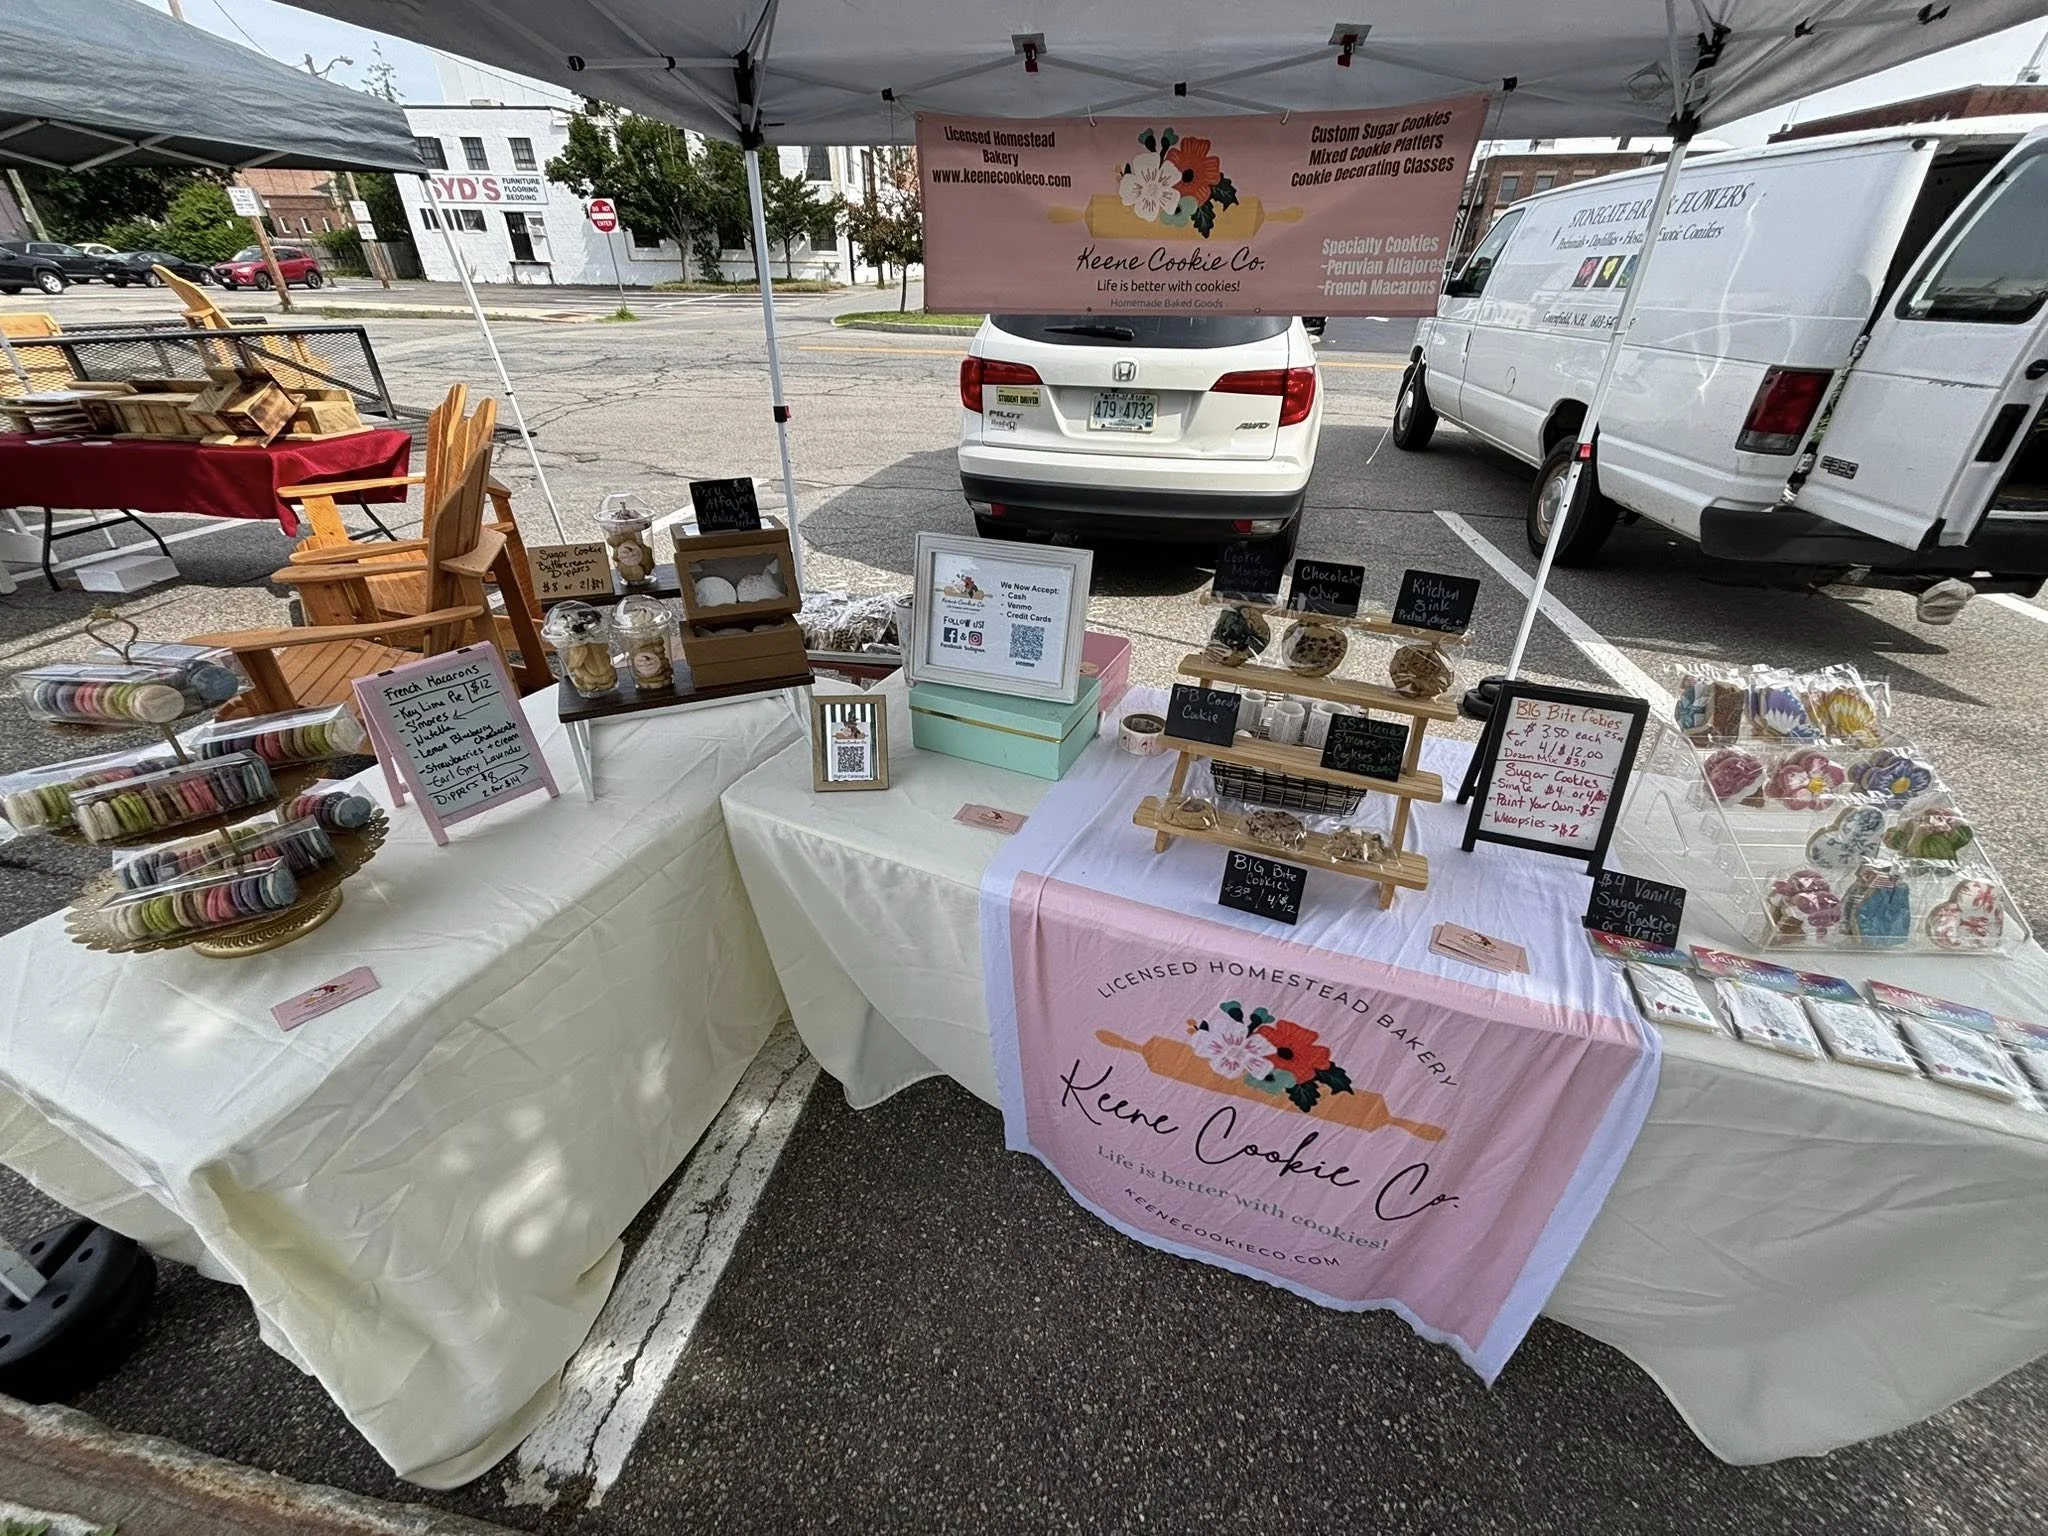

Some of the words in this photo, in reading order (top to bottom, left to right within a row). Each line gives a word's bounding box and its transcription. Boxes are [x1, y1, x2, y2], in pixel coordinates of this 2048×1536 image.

[1311, 125, 1360, 144] Custom
[1361, 119, 1399, 141] Sugar
[1400, 110, 1452, 134] Cookies
[944, 126, 991, 146] Licensed
[993, 130, 1056, 149] Homestead
[982, 149, 1019, 168] Bakery
[1308, 146, 1347, 167] Mixed
[1350, 141, 1391, 162] Cookie
[1392, 133, 1444, 154] Platters
[931, 168, 1072, 188] www.keenecookieco.com
[1291, 169, 1331, 187] Cookie
[1334, 158, 1401, 183] Decorating
[1403, 155, 1455, 175] Classes
[502, 177, 541, 186] FURNITURE
[504, 185, 539, 193] FLOORING
[1677, 183, 1755, 214] FLOWERS
[1322, 237, 1381, 256] Specialty
[1385, 235, 1440, 254] Cookies
[1077, 244, 1145, 273] Keene
[1147, 246, 1230, 274] Cookie
[1231, 246, 1265, 273] Co.
[1386, 256, 1445, 276] Alfajores
[1097, 279, 1118, 292] Life
[1119, 280, 1129, 292] is
[1130, 280, 1166, 293] better
[1167, 280, 1193, 293] with
[1194, 280, 1241, 293] cookies!
[1369, 278, 1437, 296] Macarons
[1110, 298, 1163, 308] Homemade
[1164, 298, 1193, 308] Baked
[1194, 298, 1224, 308] Goods
[998, 394, 1019, 404] STUDENT
[1019, 395, 1039, 405] DRIVER
[1094, 399, 1117, 419] 479
[1123, 401, 1154, 420] 4732
[989, 409, 1024, 420] PILOT
[1234, 422, 1271, 431] AWD
[1820, 456, 1859, 475] E350
[539, 549, 569, 563] Sugar
[573, 545, 602, 557] Cookie
[1301, 565, 1361, 588] Chocolate
[1000, 581, 1012, 590] We
[1013, 583, 1031, 591] Now
[1031, 585, 1060, 595] Accept:
[1007, 592, 1027, 600] Cash
[1309, 583, 1340, 604] Chip
[1413, 577, 1460, 601] Kitchen
[1007, 601, 1033, 611] Venmo
[1414, 599, 1451, 612] Sink
[1006, 611, 1029, 620] Credit
[1029, 613, 1052, 623] Cards
[383, 682, 423, 701] French
[425, 664, 480, 688] Macarons
[470, 679, 493, 695] $12
[417, 699, 446, 713] Lime
[447, 690, 465, 704] Pie
[1176, 686, 1200, 703] PB
[1181, 704, 1219, 724] Cookie
[1516, 700, 1541, 718] BIG
[1546, 704, 1577, 723] Bite
[1582, 708, 1623, 730] Cookies
[1514, 739, 1527, 747] or
[1575, 732, 1602, 745] each
[456, 763, 480, 777] Grey
[482, 745, 521, 766] Lavender
[1504, 747, 1535, 760] Dozen
[1537, 752, 1558, 764] Mix
[1564, 757, 1587, 768] $30
[1505, 762, 1549, 783] Sugar
[1554, 770, 1600, 789] Cookies
[433, 779, 479, 806] Dippers
[482, 790, 490, 798] 2
[1572, 790, 1584, 799] or
[1529, 797, 1551, 812] Your
[1551, 800, 1574, 813] Own
[1233, 854, 1265, 876] BIG
[1273, 864, 1297, 882] Bite
[1246, 872, 1290, 892] Cookies
[1600, 873, 1626, 894] $4
[1635, 880, 1683, 909] Vanilla
[1597, 891, 1643, 918] Sugar
[1601, 921, 1620, 931] or
[1627, 910, 1678, 935] Cookies
[1098, 961, 1198, 999] LICENSED
[1209, 961, 1370, 1015] HOMESTEAD
[1375, 1013, 1459, 1089] BAKERY
[1060, 1058, 1180, 1134] Keene
[1195, 1106, 1361, 1187] Cookie
[1374, 1162, 1461, 1222] Co.
[1097, 1144, 1134, 1170] Life
[1137, 1162, 1157, 1180] is
[1160, 1168, 1230, 1200] better
[1233, 1193, 1286, 1221] with
[1291, 1214, 1390, 1252] cookies!
[1124, 1187, 1342, 1269] KEENECOOKIECO.COM
